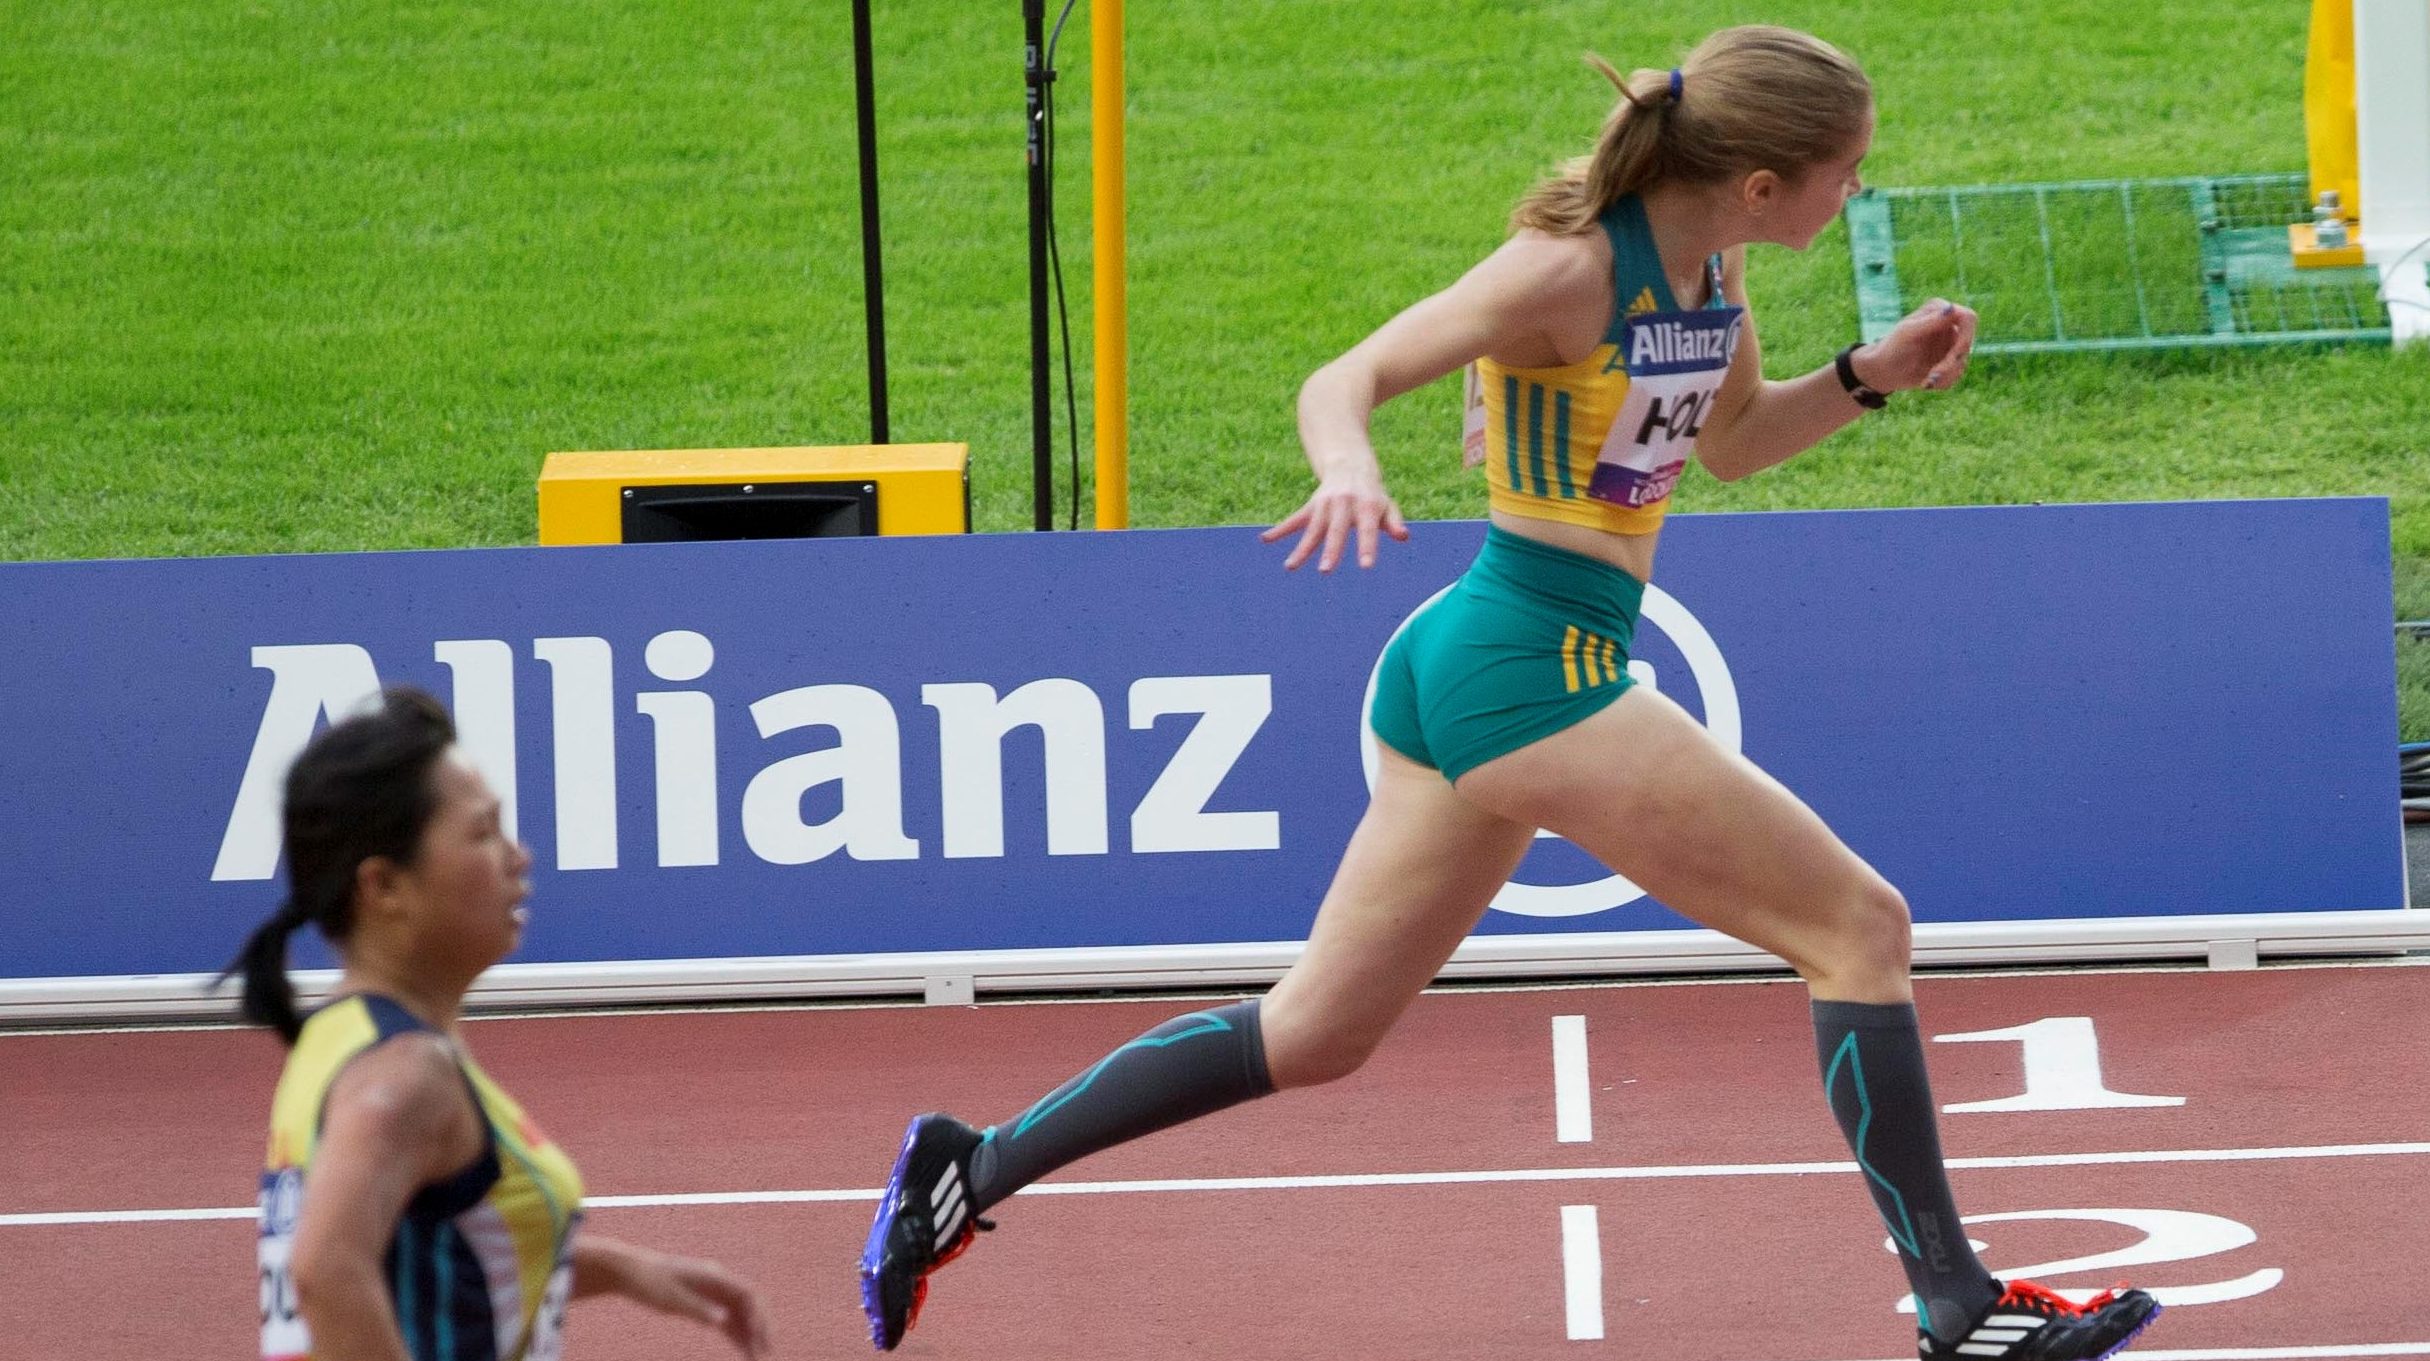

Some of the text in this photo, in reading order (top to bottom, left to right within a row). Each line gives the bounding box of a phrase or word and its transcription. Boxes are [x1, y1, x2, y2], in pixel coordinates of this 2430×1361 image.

[1631, 321, 1725, 365] Allianz
[1635, 389, 1718, 446] HOL
[210, 630, 1281, 881] Allianz
[1932, 1016, 2187, 1113] 1
[1884, 1208, 2284, 1314] 2
